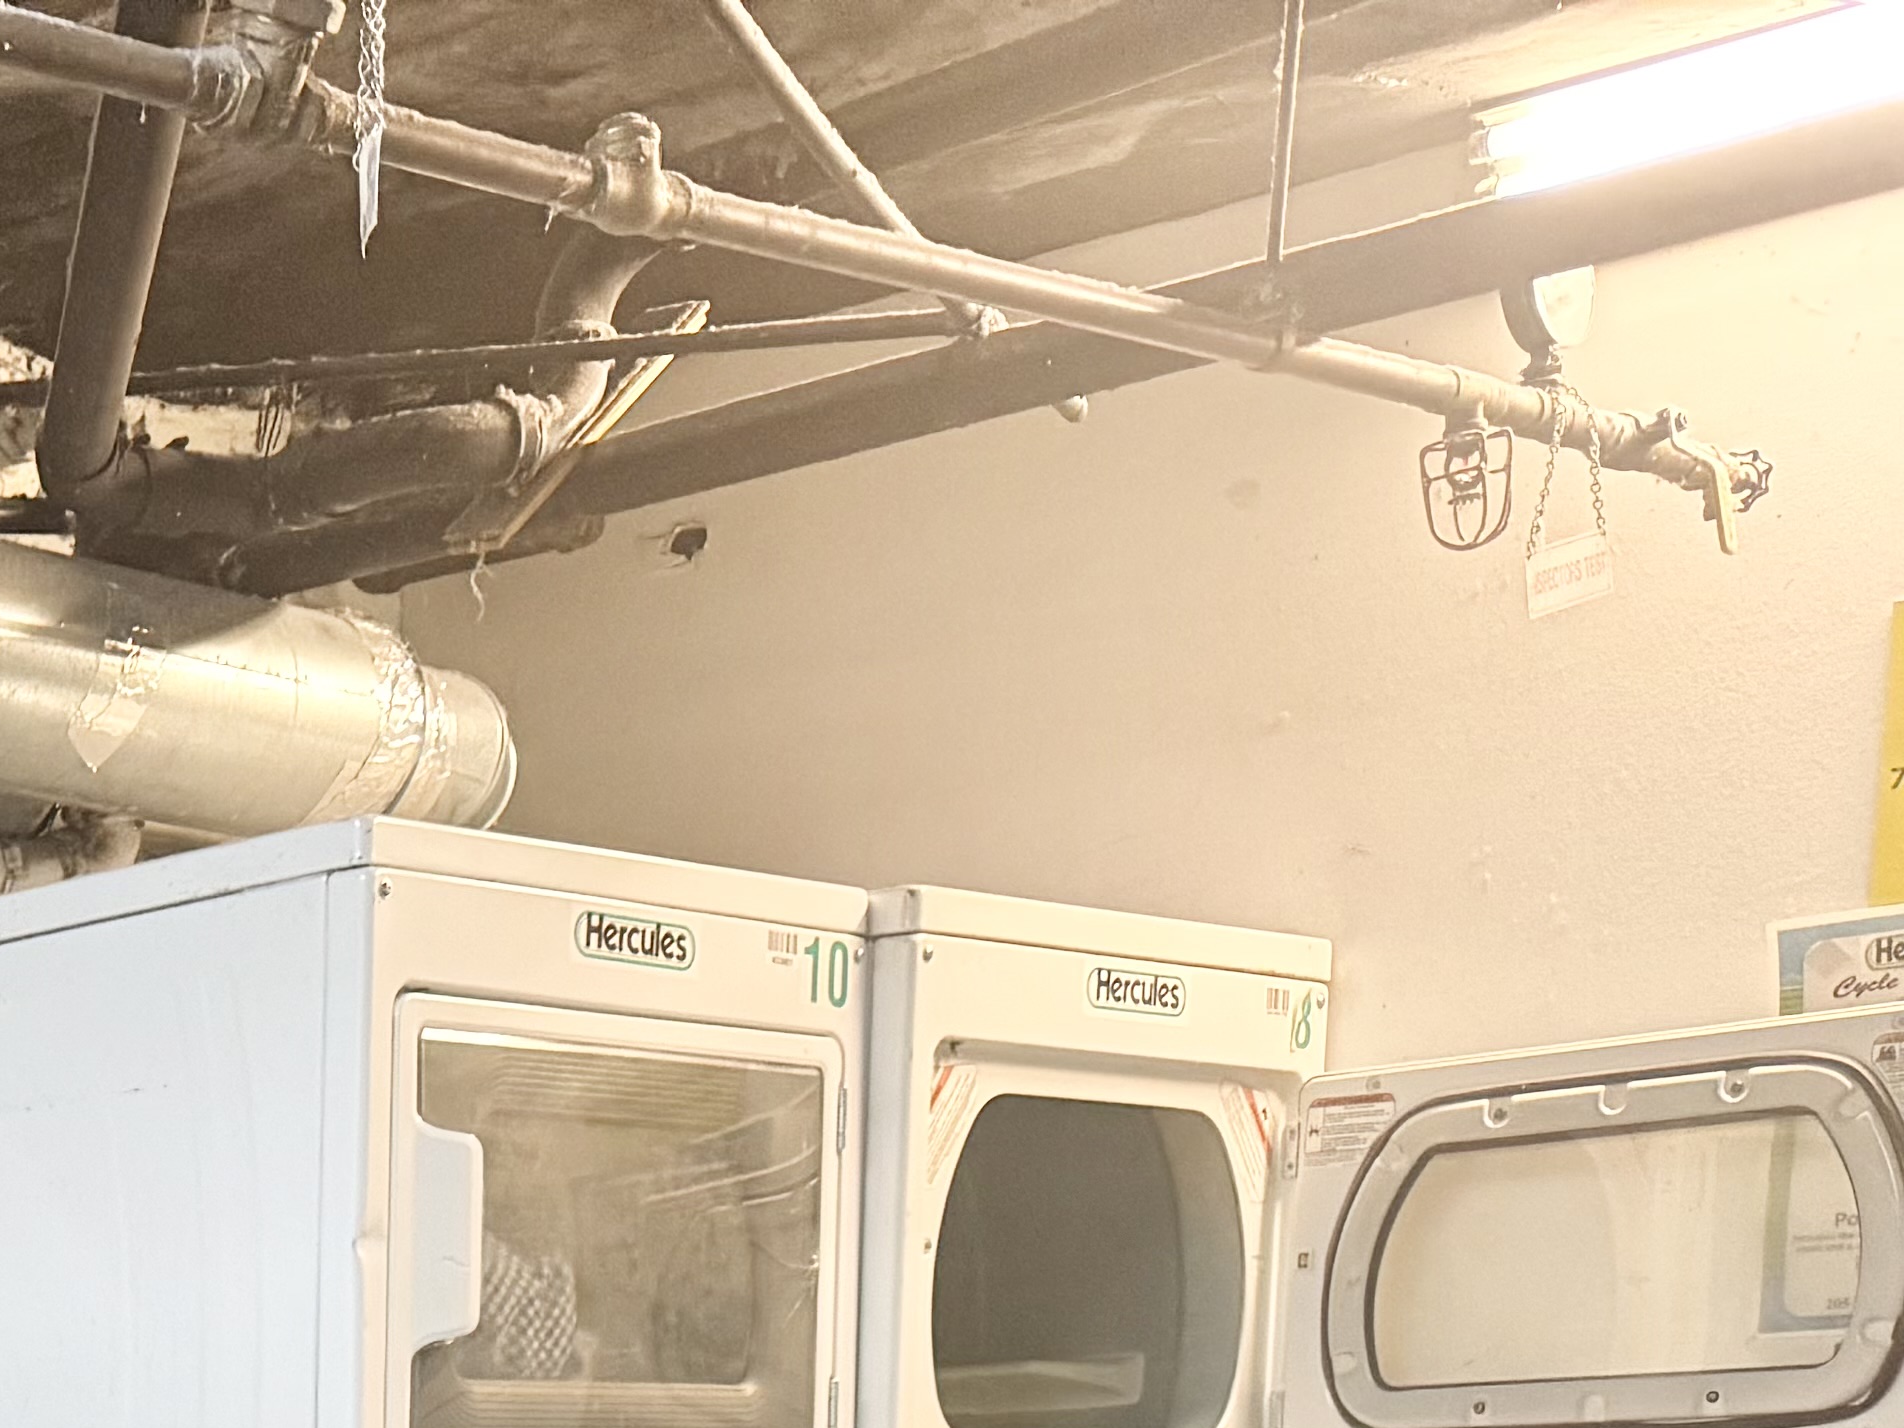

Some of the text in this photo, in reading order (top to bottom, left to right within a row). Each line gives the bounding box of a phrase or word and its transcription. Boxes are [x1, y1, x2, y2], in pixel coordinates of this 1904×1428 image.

[585, 911, 687, 962] Hercules
[803, 936, 849, 1008] 10
[1096, 968, 1180, 1010] Hercules
[1832, 972, 1900, 999] Cycle
